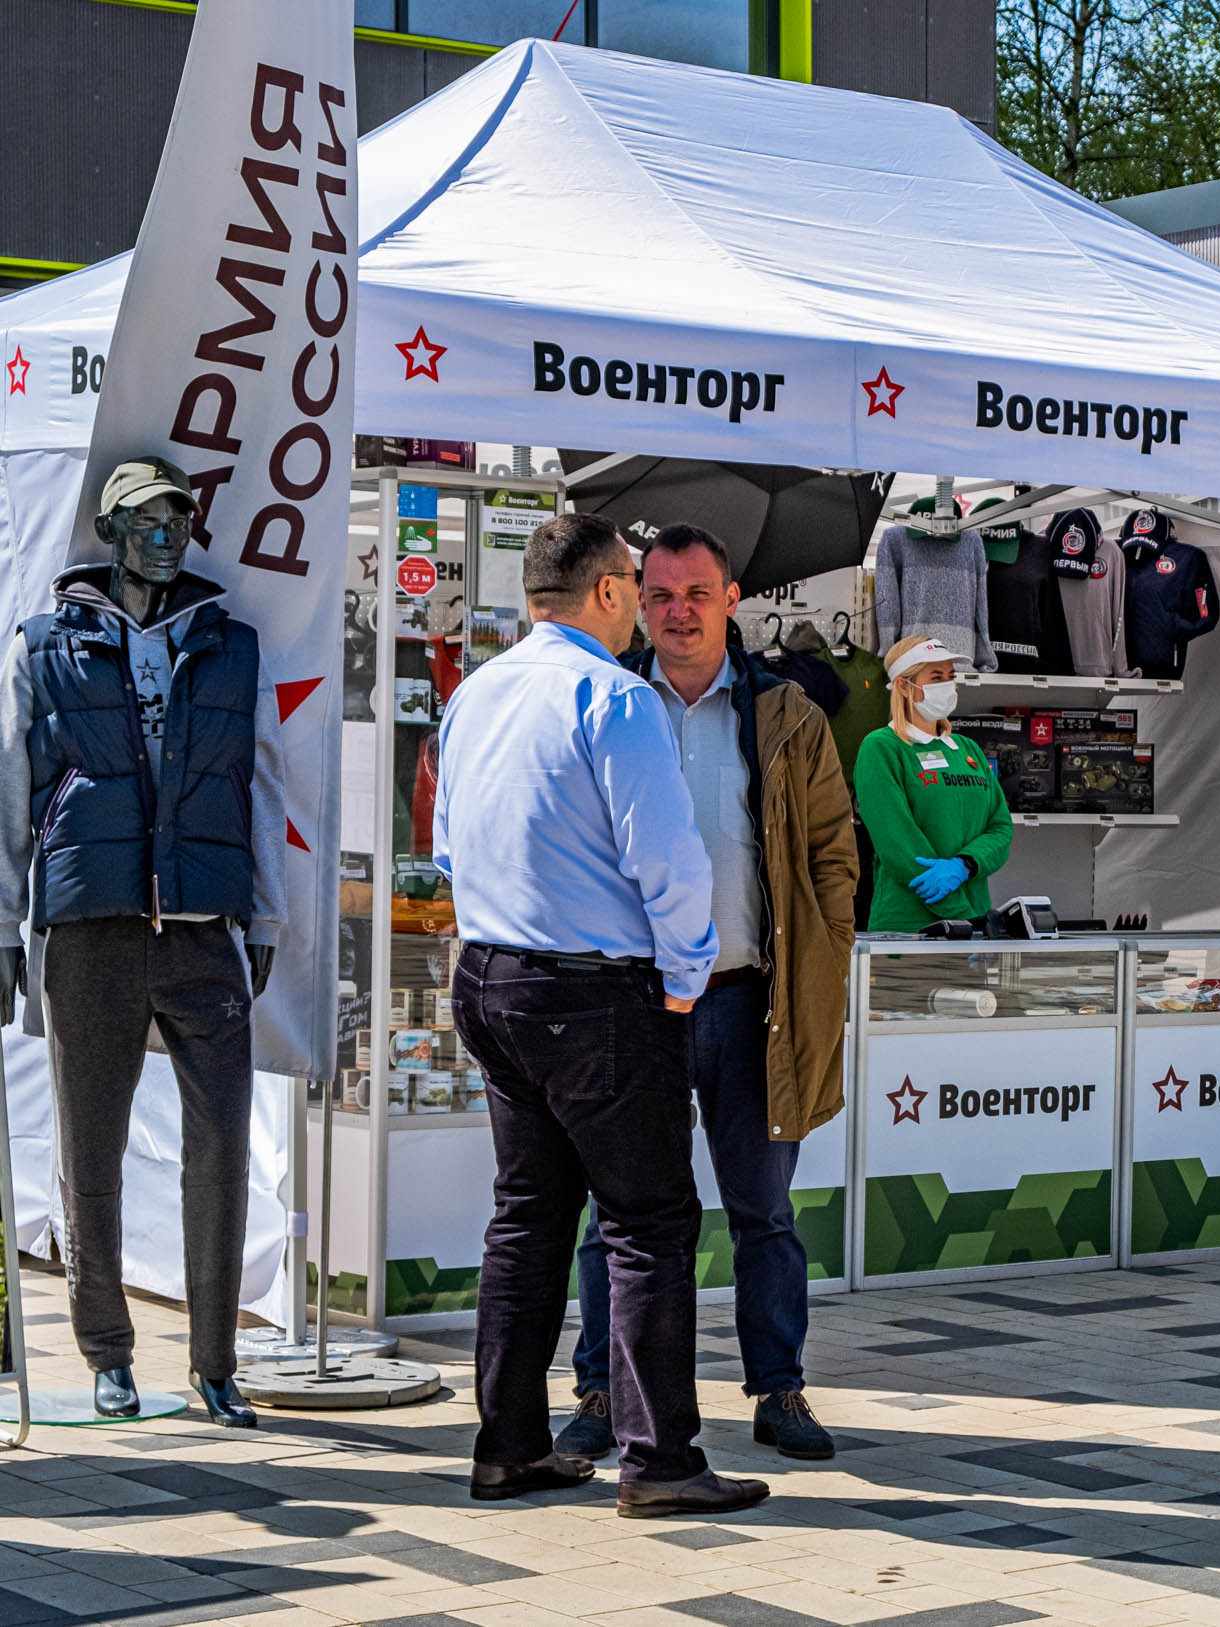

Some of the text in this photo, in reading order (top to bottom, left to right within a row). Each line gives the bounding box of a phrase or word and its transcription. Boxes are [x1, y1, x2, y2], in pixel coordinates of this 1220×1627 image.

[168, 62, 305, 552] АРМИЯ
[239, 82, 349, 577] РОССИИ
[533, 341, 785, 424] Военторг
[975, 380, 1188, 455] Военторг
[981, 527, 1017, 538] РМИЯ
[402, 572, 420, 583] 1,5
[941, 771, 988, 791] Воентор
[938, 1084, 1096, 1122] Военторг
